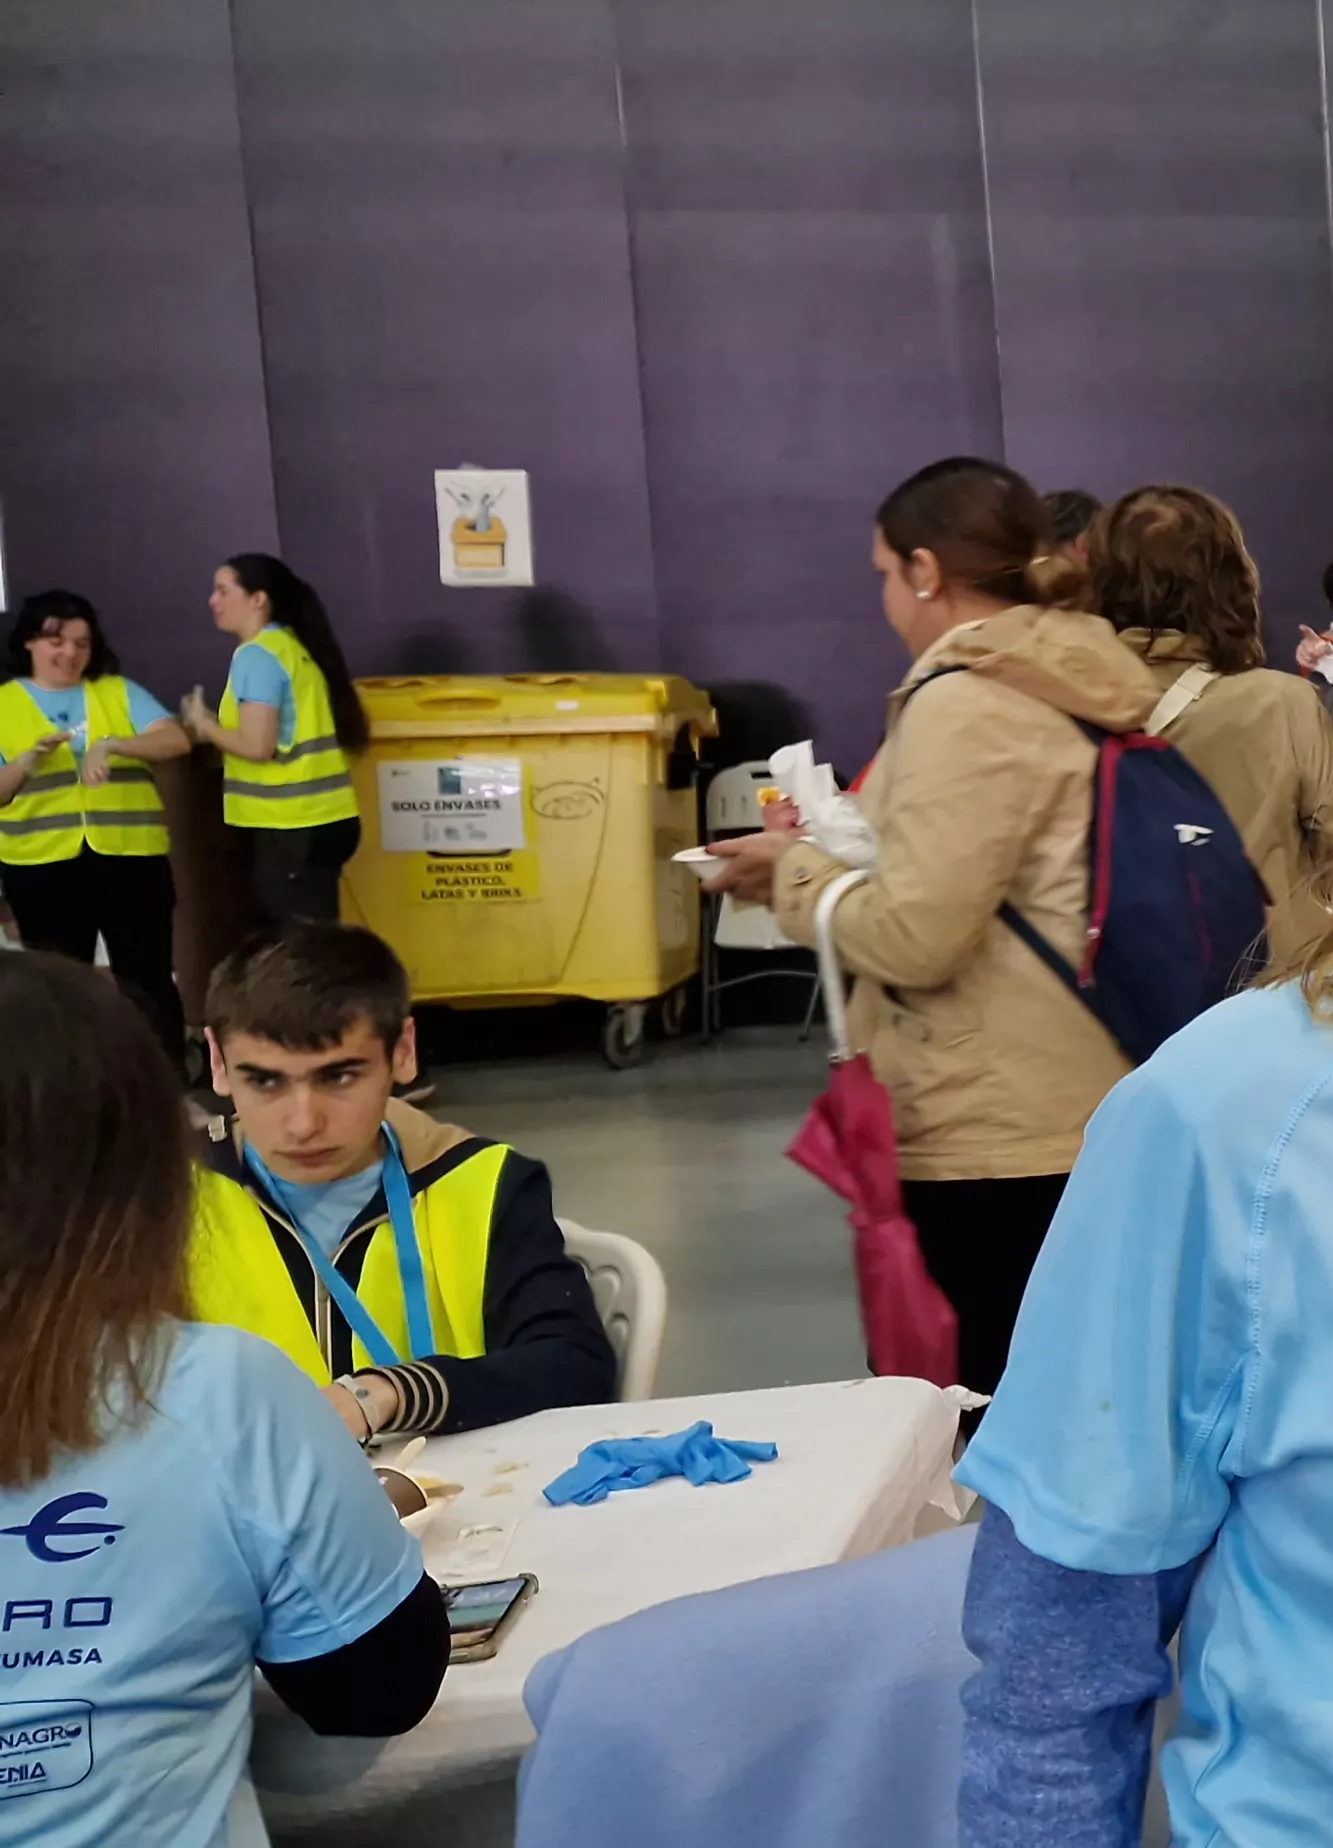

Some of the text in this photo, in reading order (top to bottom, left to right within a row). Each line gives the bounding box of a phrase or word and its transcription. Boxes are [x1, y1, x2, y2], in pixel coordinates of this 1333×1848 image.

[391, 799, 500, 812] SOLO ENVASES
[0, 1648, 103, 1669] UMASA
